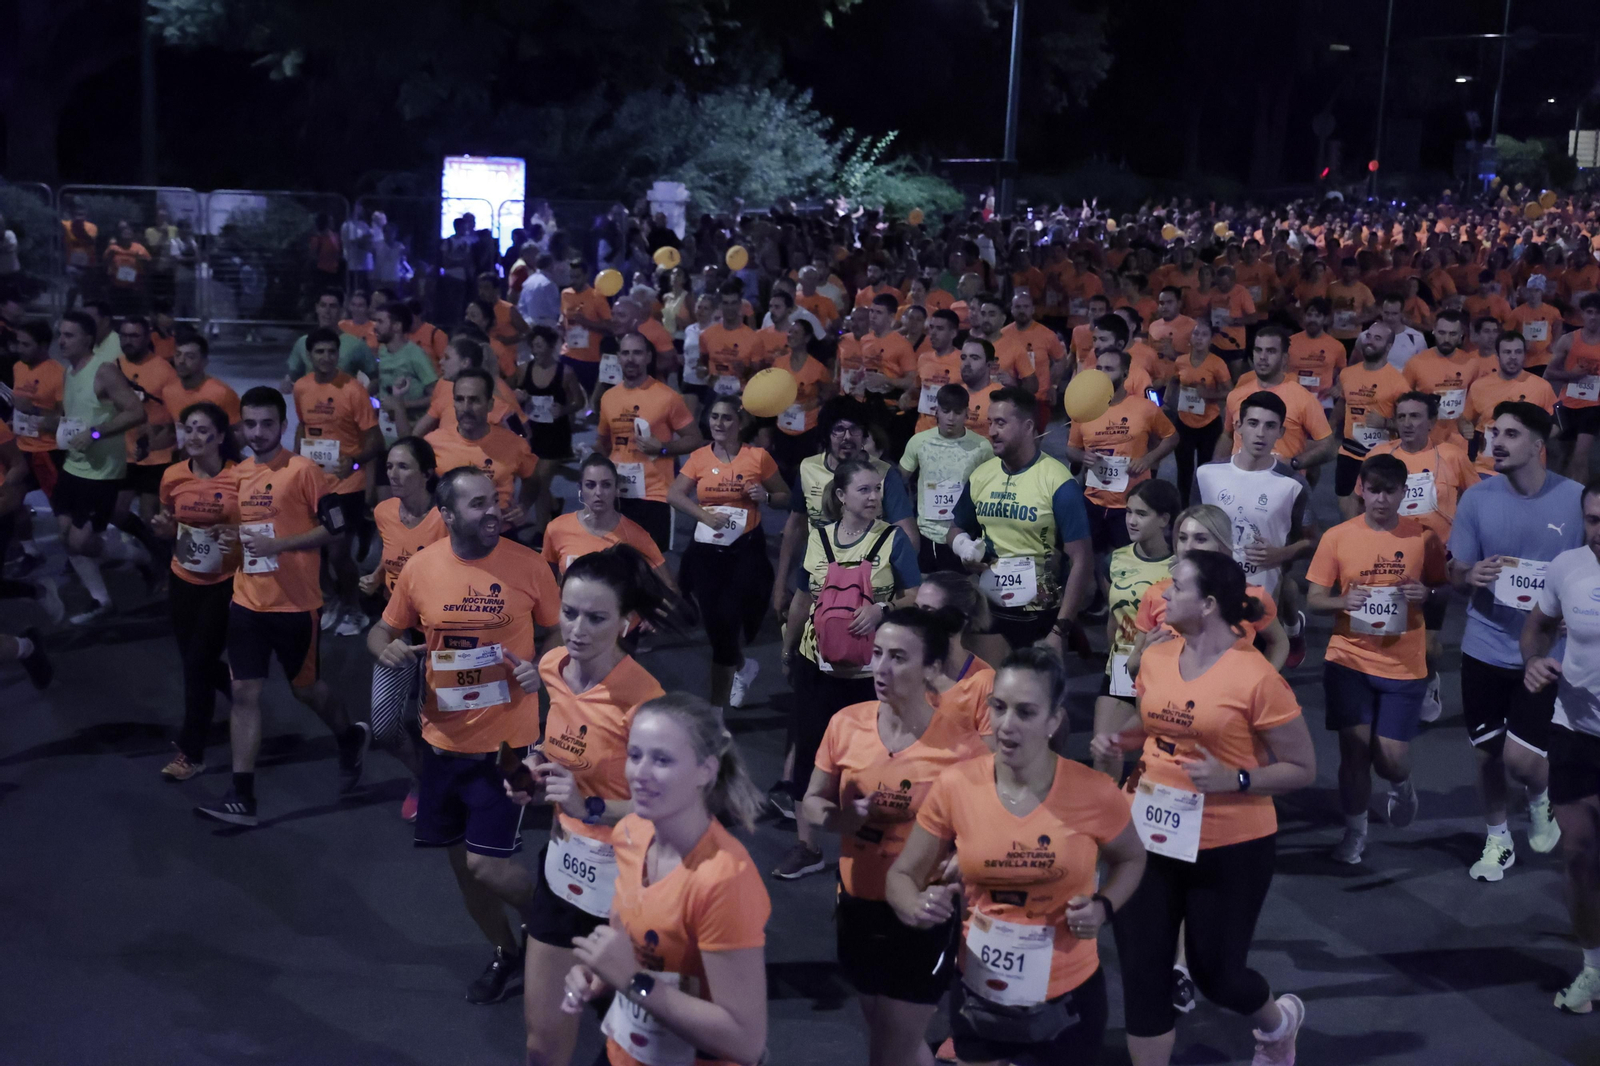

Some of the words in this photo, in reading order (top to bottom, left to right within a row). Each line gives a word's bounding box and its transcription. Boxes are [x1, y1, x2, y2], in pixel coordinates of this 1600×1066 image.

[1363, 432, 1382, 440] 3420
[1099, 466, 1119, 477] 3733
[934, 494, 954, 505] 3734
[995, 574, 1022, 587] 7294
[1510, 575, 1545, 590] 16044
[462, 597, 505, 606] NOCTURNA
[443, 604, 481, 612] SEVILLA
[1363, 603, 1398, 615] 16042
[457, 669, 482, 686] 857
[1147, 711, 1175, 723] SEVILLA
[549, 736, 571, 752] SEVILLA
[1146, 805, 1181, 829] 6079
[563, 853, 597, 883] 6695
[984, 859, 1028, 868] SEVILLA
[981, 945, 1025, 973] 6251
